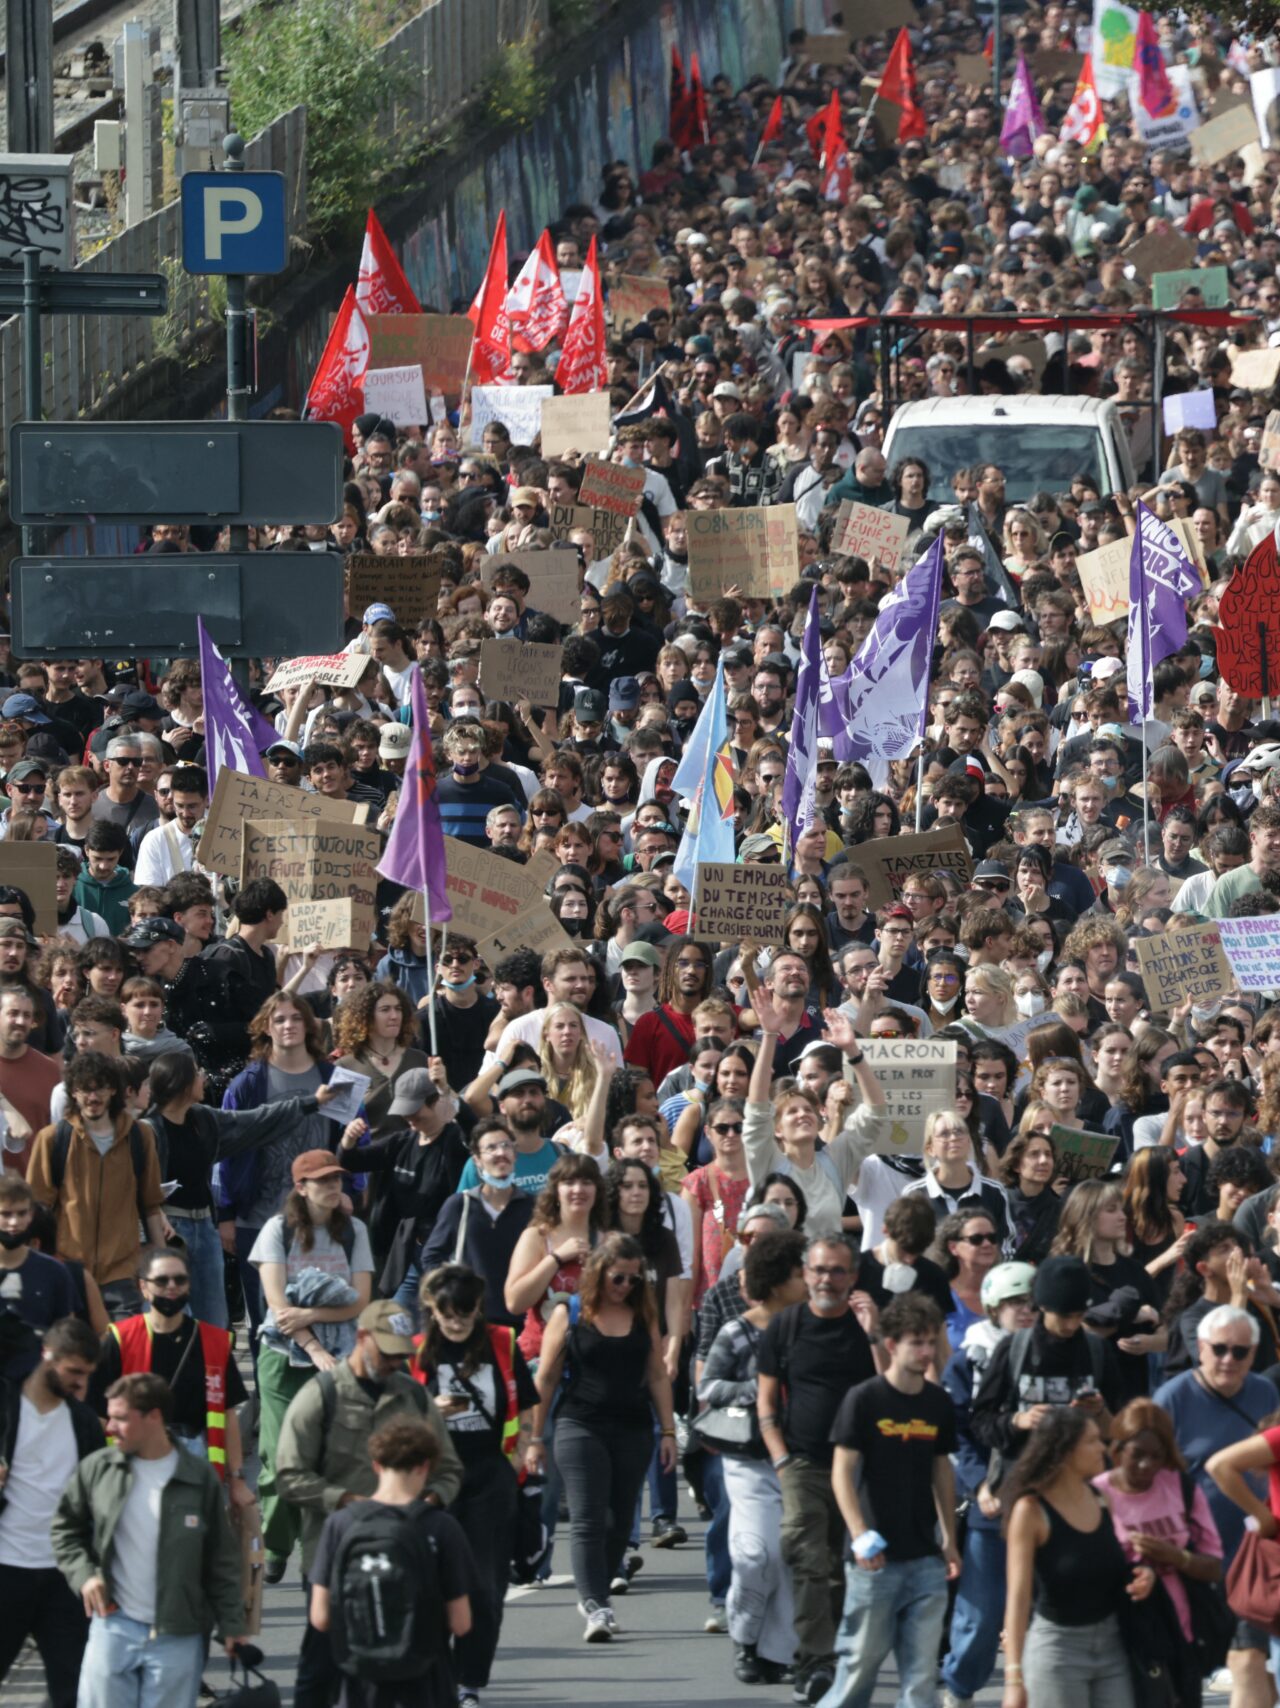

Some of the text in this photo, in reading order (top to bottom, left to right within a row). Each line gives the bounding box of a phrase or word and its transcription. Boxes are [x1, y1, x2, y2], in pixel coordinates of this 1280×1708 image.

[202, 187, 264, 260] P
[580, 489, 637, 516] FAVORABLE
[554, 506, 575, 526] DU
[842, 517, 882, 539] JEUNE
[1089, 570, 1130, 591] ENFL
[236, 778, 259, 800] TA
[264, 786, 293, 809] PAS
[249, 834, 379, 860] C'EST TOUJOURS
[882, 852, 967, 873] TAXEZ LES
[703, 868, 724, 882] UN
[288, 881, 325, 899] NOUS
[703, 889, 720, 903] DU
[700, 904, 780, 921] CHARGÉ QUE
[699, 920, 715, 935] LE
[717, 922, 752, 937] CASIER
[1218, 920, 1236, 935] MA
[1150, 938, 1170, 956] LA
[1176, 931, 1202, 949] PUFF
[1246, 935, 1270, 948] LEUR
[1203, 946, 1217, 959] DE
[1199, 962, 1220, 976] QUE
[1158, 978, 1223, 1006] LES KEUFS
[861, 1042, 945, 1060] MACRON
[890, 1069, 935, 1081] TA PROF
[902, 1090, 923, 1101] LES
[887, 1104, 922, 1116] TRES
